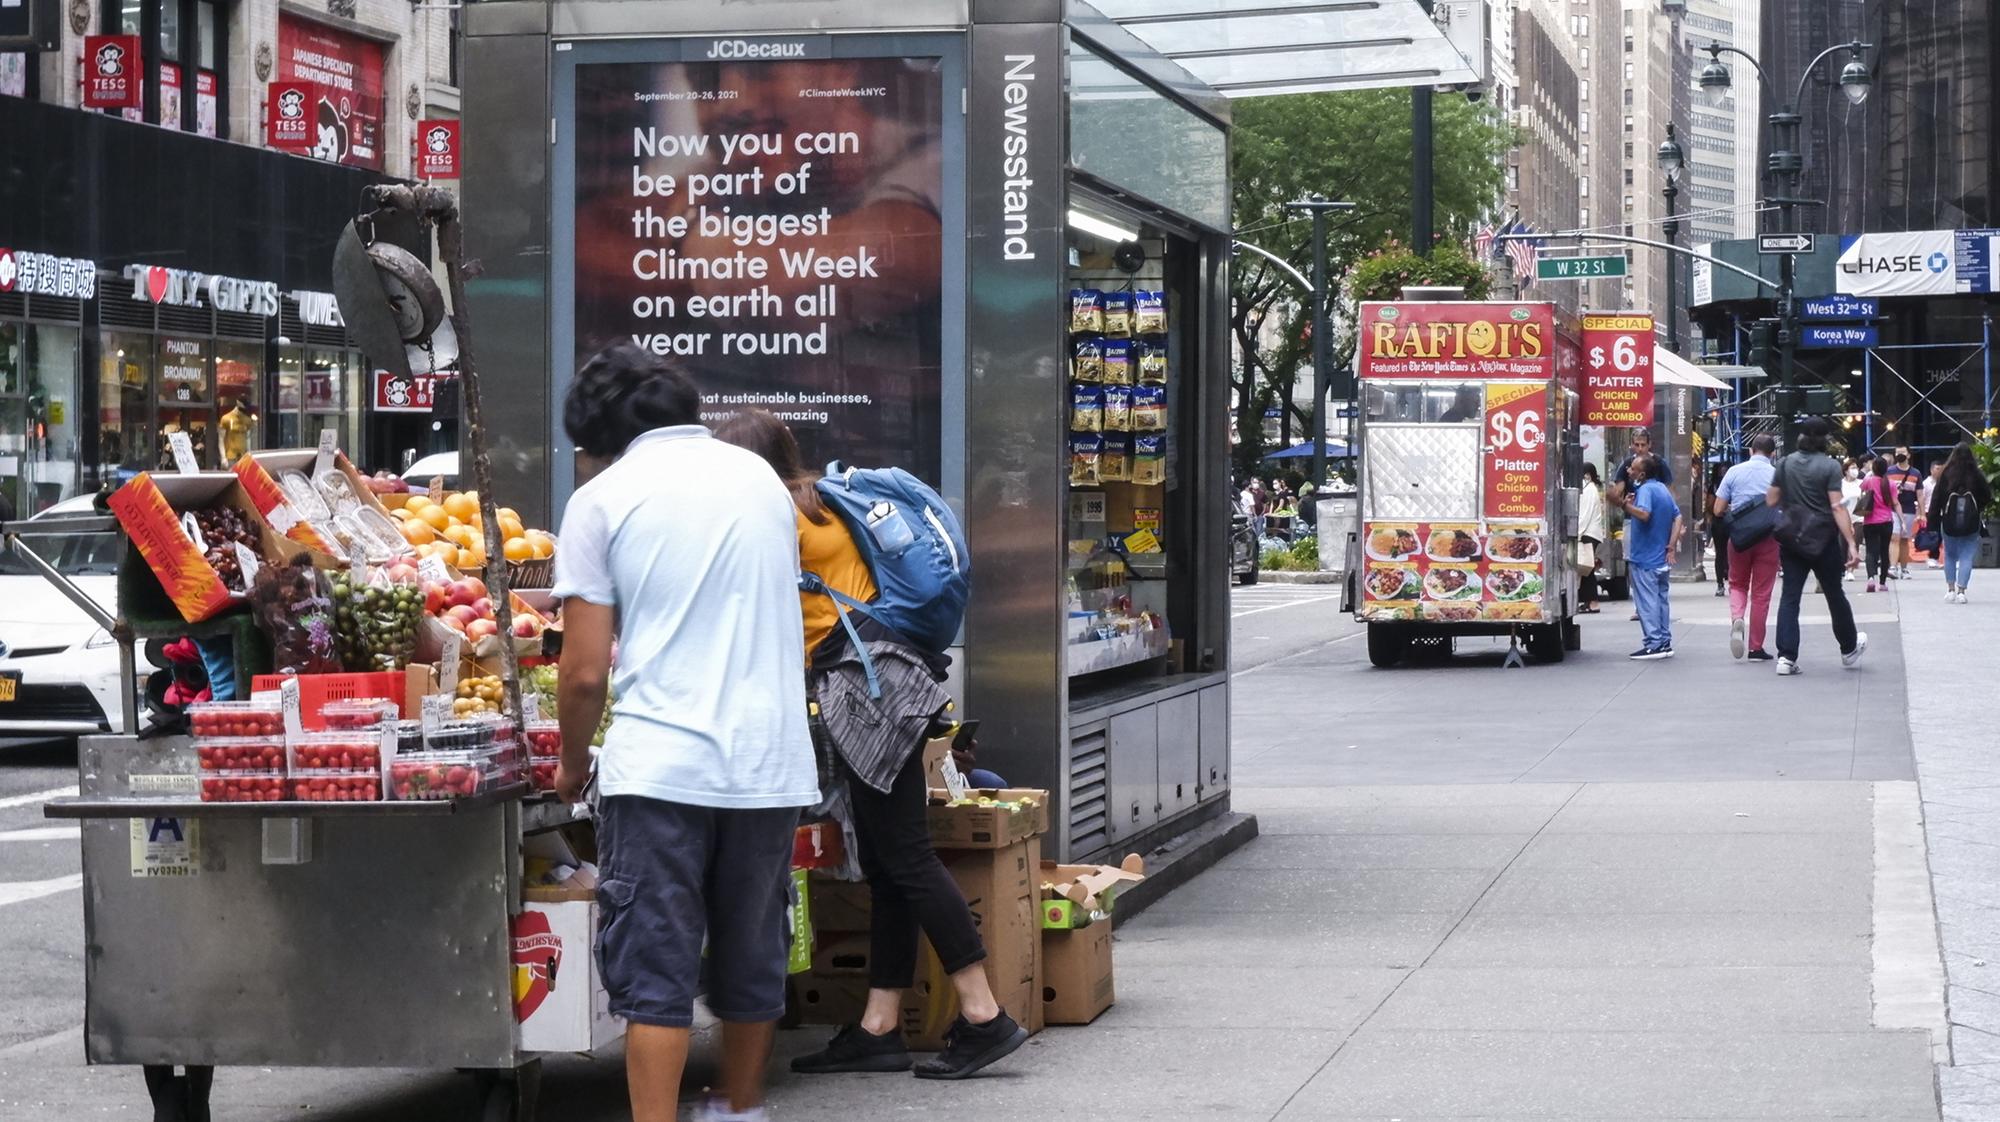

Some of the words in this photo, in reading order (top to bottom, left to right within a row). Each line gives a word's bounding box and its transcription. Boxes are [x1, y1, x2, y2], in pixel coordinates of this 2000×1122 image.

[706, 40, 805, 59] JCDecaux
[293, 48, 322, 68] JAPANESE
[323, 55, 353, 76] SPECIALTY
[93, 78, 126, 90] TESO
[294, 64, 334, 84] DEPARTMENT
[334, 74, 353, 91] STORE
[634, 91, 682, 101] September
[686, 90, 714, 99] 20-26,
[717, 90, 738, 98] 2021
[799, 87, 886, 97] #ClimateWeekNYC
[276, 120, 306, 131] TESO
[633, 126, 710, 156] Now
[719, 135, 782, 165] you
[794, 130, 859, 154] can
[424, 155, 453, 164] TESO
[1003, 54, 1036, 260] Newsstand
[633, 166, 675, 197] be
[688, 166, 763, 204] part
[774, 162, 811, 194] of
[632, 207, 688, 238] the
[699, 206, 831, 246] biggest
[632, 247, 767, 280] Climate
[779, 246, 878, 278] Week
[1557, 263, 1568, 275] W
[1574, 262, 1588, 274] 32
[1593, 261, 1605, 273] St
[19, 253, 95, 299] 特搜商城
[165, 267, 201, 307] NY
[209, 275, 277, 316] GIFTS
[632, 295, 674, 318] on
[686, 285, 782, 318] earth
[794, 284, 836, 316] all
[1807, 303, 1834, 314] West
[1837, 303, 1858, 314] 32nd
[1861, 303, 1873, 314] St
[1584, 318, 1650, 329] SPECIAL
[632, 331, 710, 356] year
[722, 323, 827, 355] round
[1371, 320, 1542, 359] RAFIQI'S
[1813, 329, 1841, 339] Korea
[1844, 329, 1866, 341] Way
[166, 340, 200, 354] PHANTOM
[164, 366, 201, 379] BROADWAY
[1370, 362, 1400, 373] Featured
[1401, 362, 1408, 372] in
[1470, 363, 1476, 372] &
[1510, 363, 1543, 375] Magazine
[1588, 376, 1643, 388] PLATTER
[699, 393, 719, 404] hat
[722, 392, 796, 404] sustainable
[799, 392, 872, 405] businesses,
[1487, 384, 1538, 409] SPECIAL
[1594, 391, 1638, 400] CHICKEN
[1602, 402, 1630, 411] LAMB
[1677, 388, 1686, 435] Newsstand
[700, 409, 741, 421] event
[774, 409, 828, 423] amazing
[1588, 412, 1604, 421] OR
[1606, 412, 1643, 422] COMBO
[1495, 459, 1540, 471] Platter
[1504, 473, 1530, 484] Gyro
[1496, 482, 1538, 493] Chicken
[1511, 494, 1522, 502] or
[1498, 503, 1536, 513] Combo
